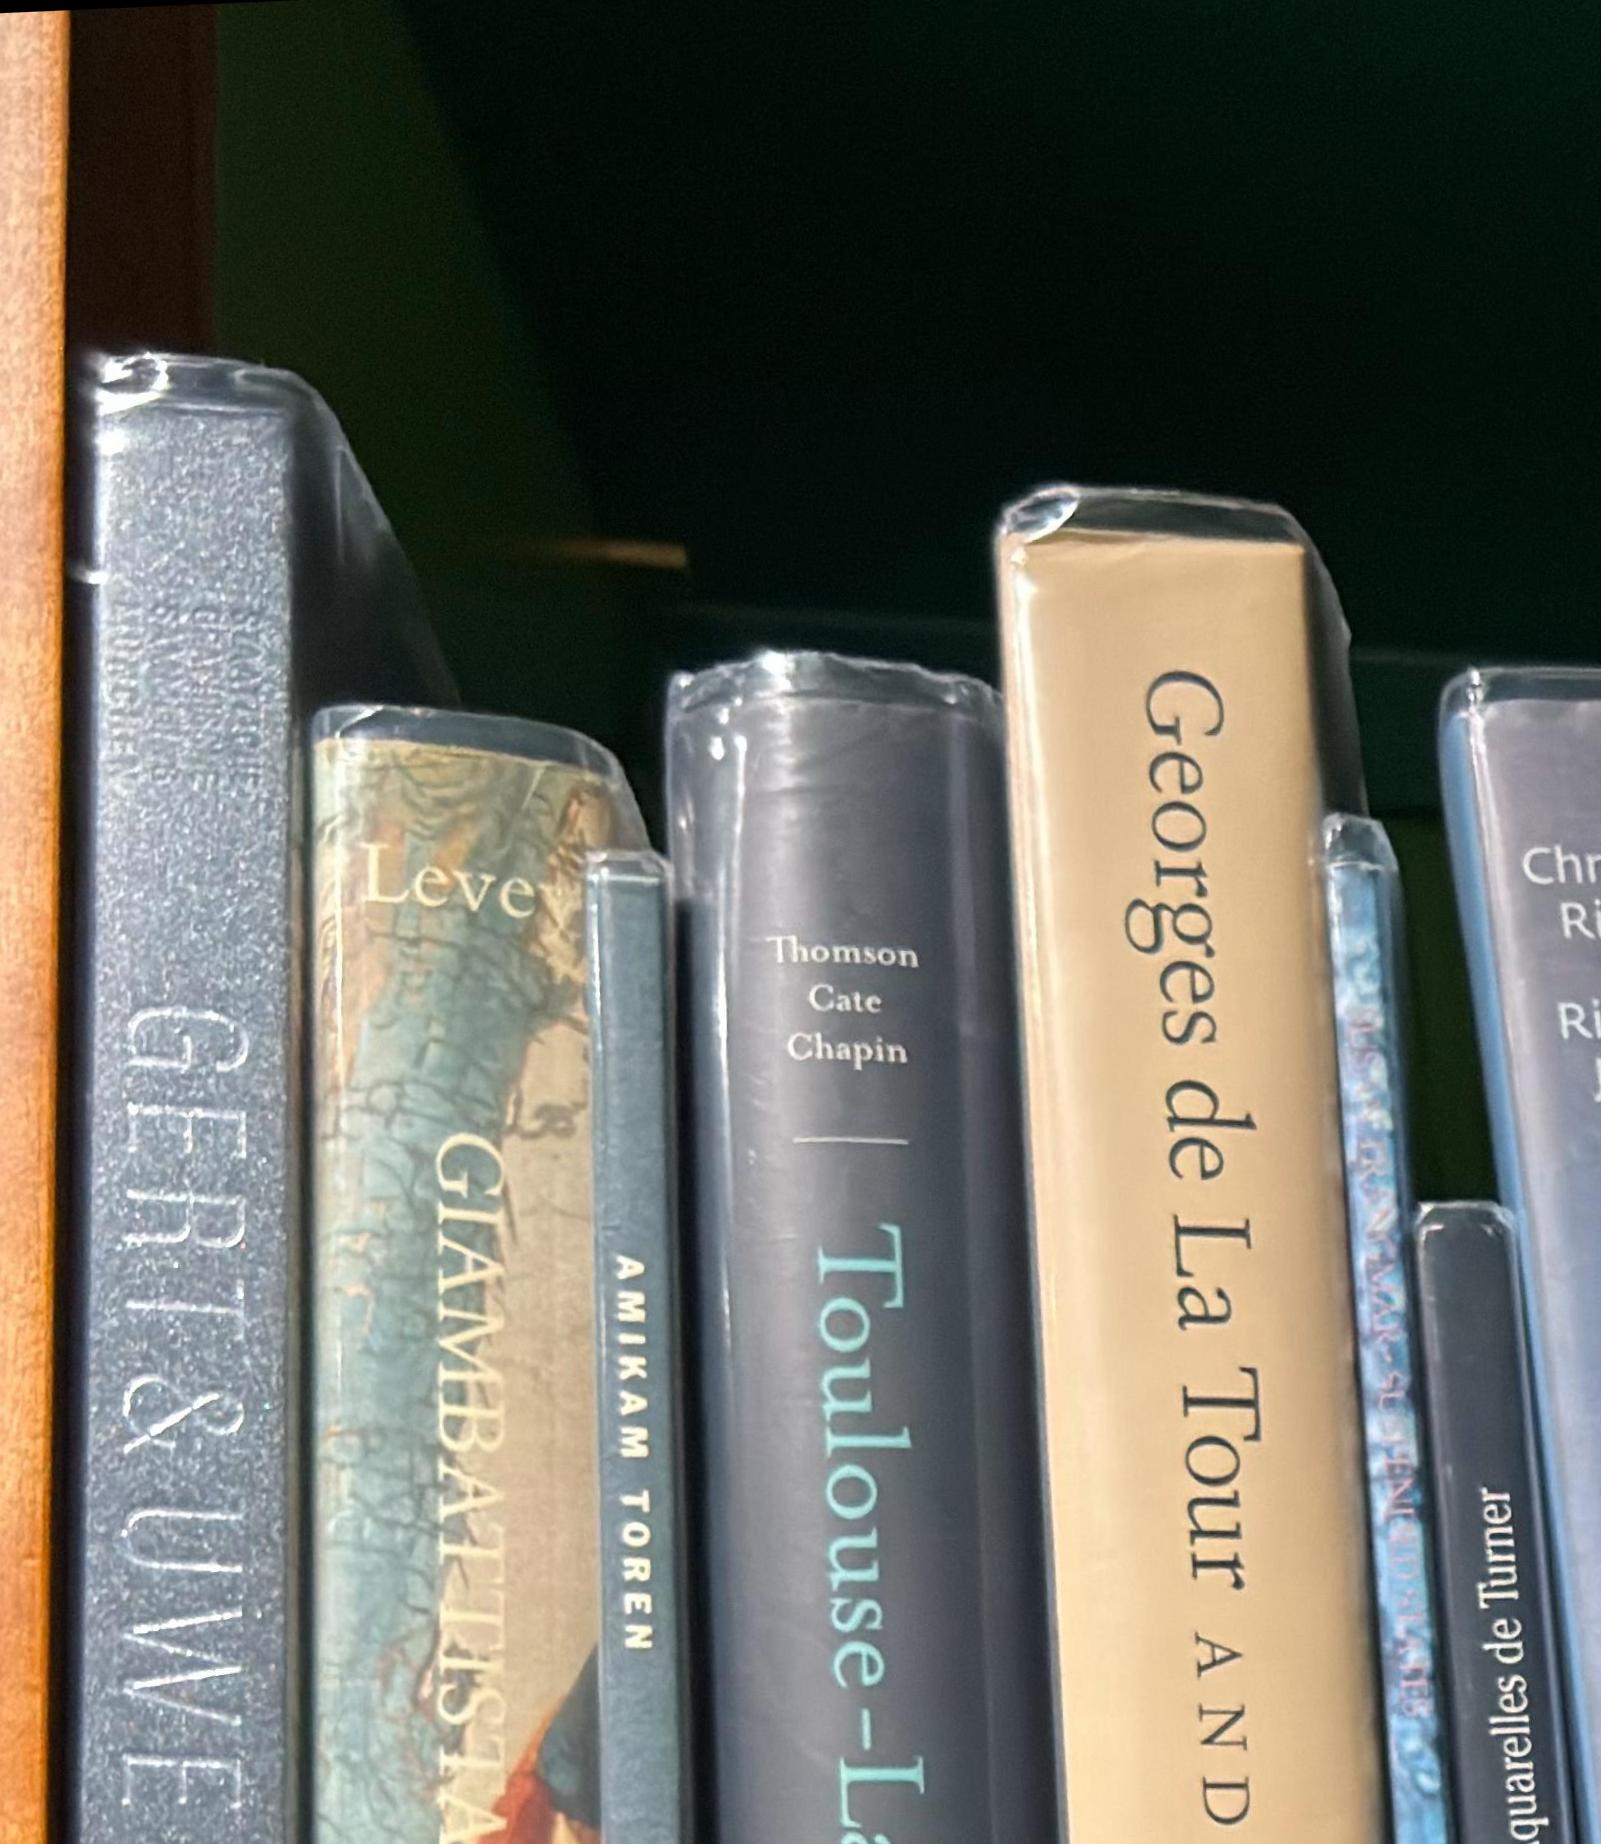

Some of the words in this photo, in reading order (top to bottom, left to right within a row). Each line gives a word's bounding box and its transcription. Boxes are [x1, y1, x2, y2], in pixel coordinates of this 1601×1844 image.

[1123, 670, 1225, 1046] Georges
[765, 935, 919, 971] Thomson
[807, 984, 882, 1016] Cate
[787, 1033, 909, 1067] Chapin
[123, 1004, 249, 1342] GERT
[1164, 1079, 1257, 1181] de
[1172, 1212, 1251, 1331] La
[124, 1374, 244, 1454] &
[615, 1256, 649, 1460] AMIKAM
[1183, 1366, 1264, 1592] Tour
[622, 1491, 655, 1650] TOREN
[1478, 1486, 1518, 1610] Turner
[119, 1507, 244, 1808] UWE
[1483, 1616, 1523, 1665] de
[1194, 1630, 1251, 1826] AND
